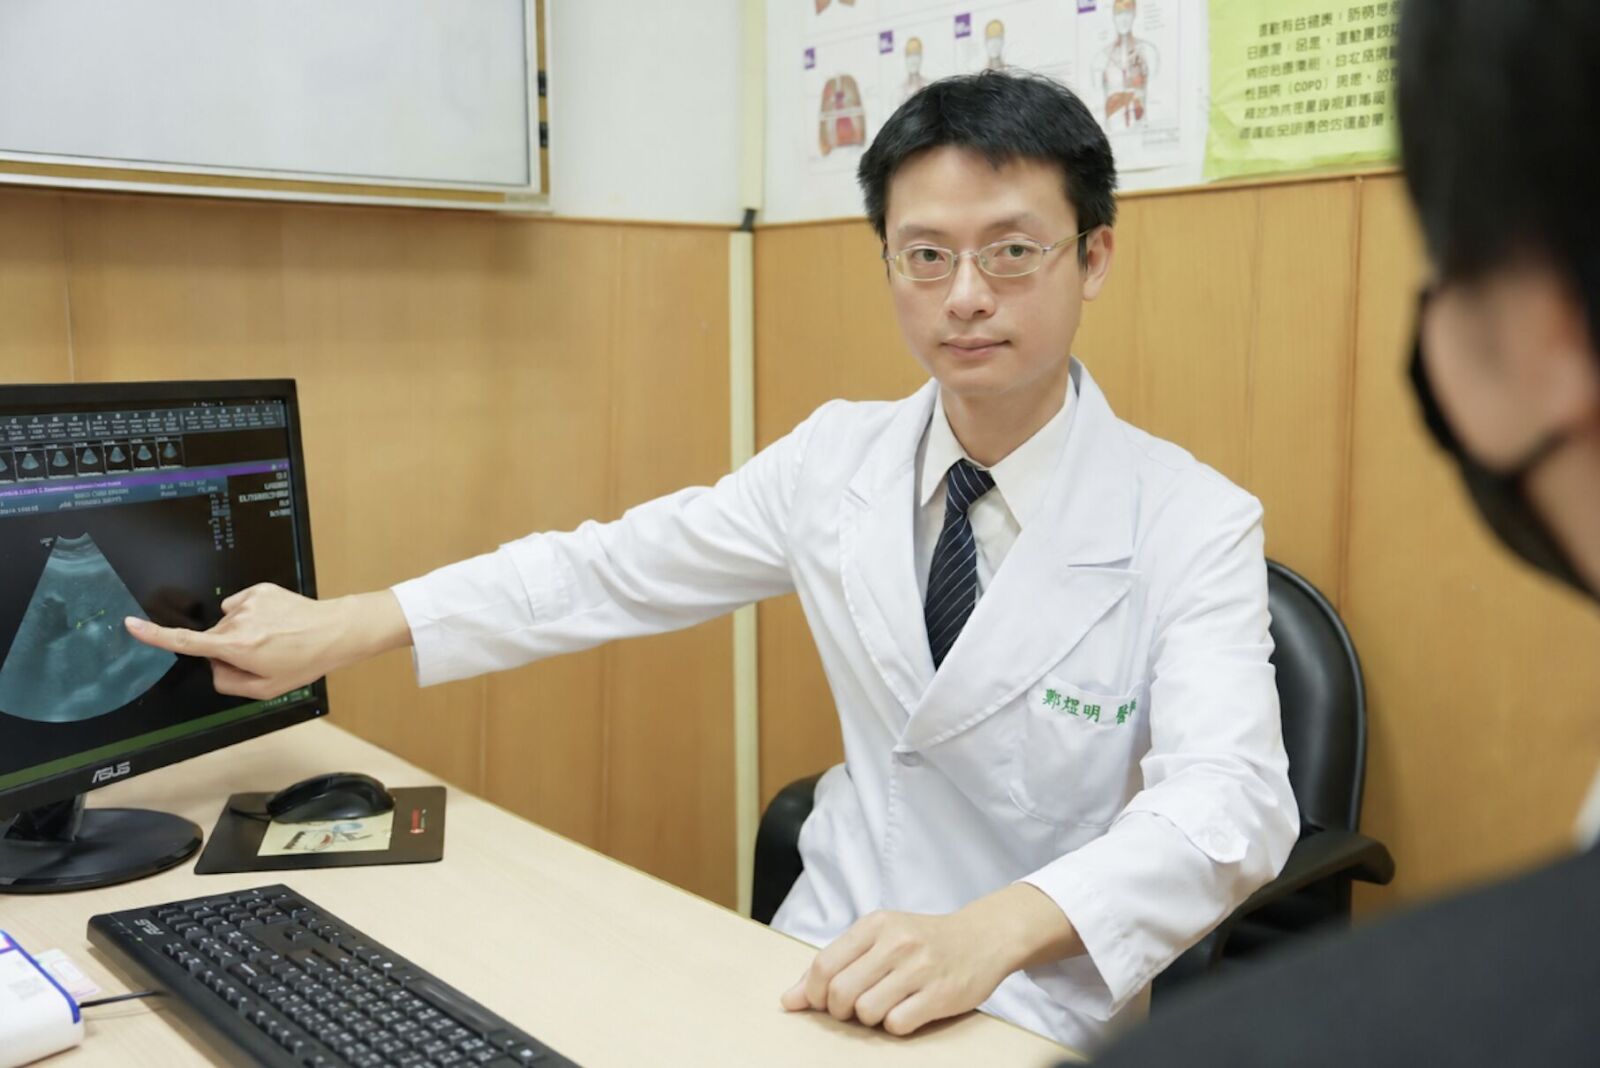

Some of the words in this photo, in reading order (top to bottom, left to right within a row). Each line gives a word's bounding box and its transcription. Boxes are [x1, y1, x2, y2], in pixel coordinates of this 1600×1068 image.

[1042, 688, 1101, 723] 鄭煜明
[91, 761, 131, 784] ASUS
